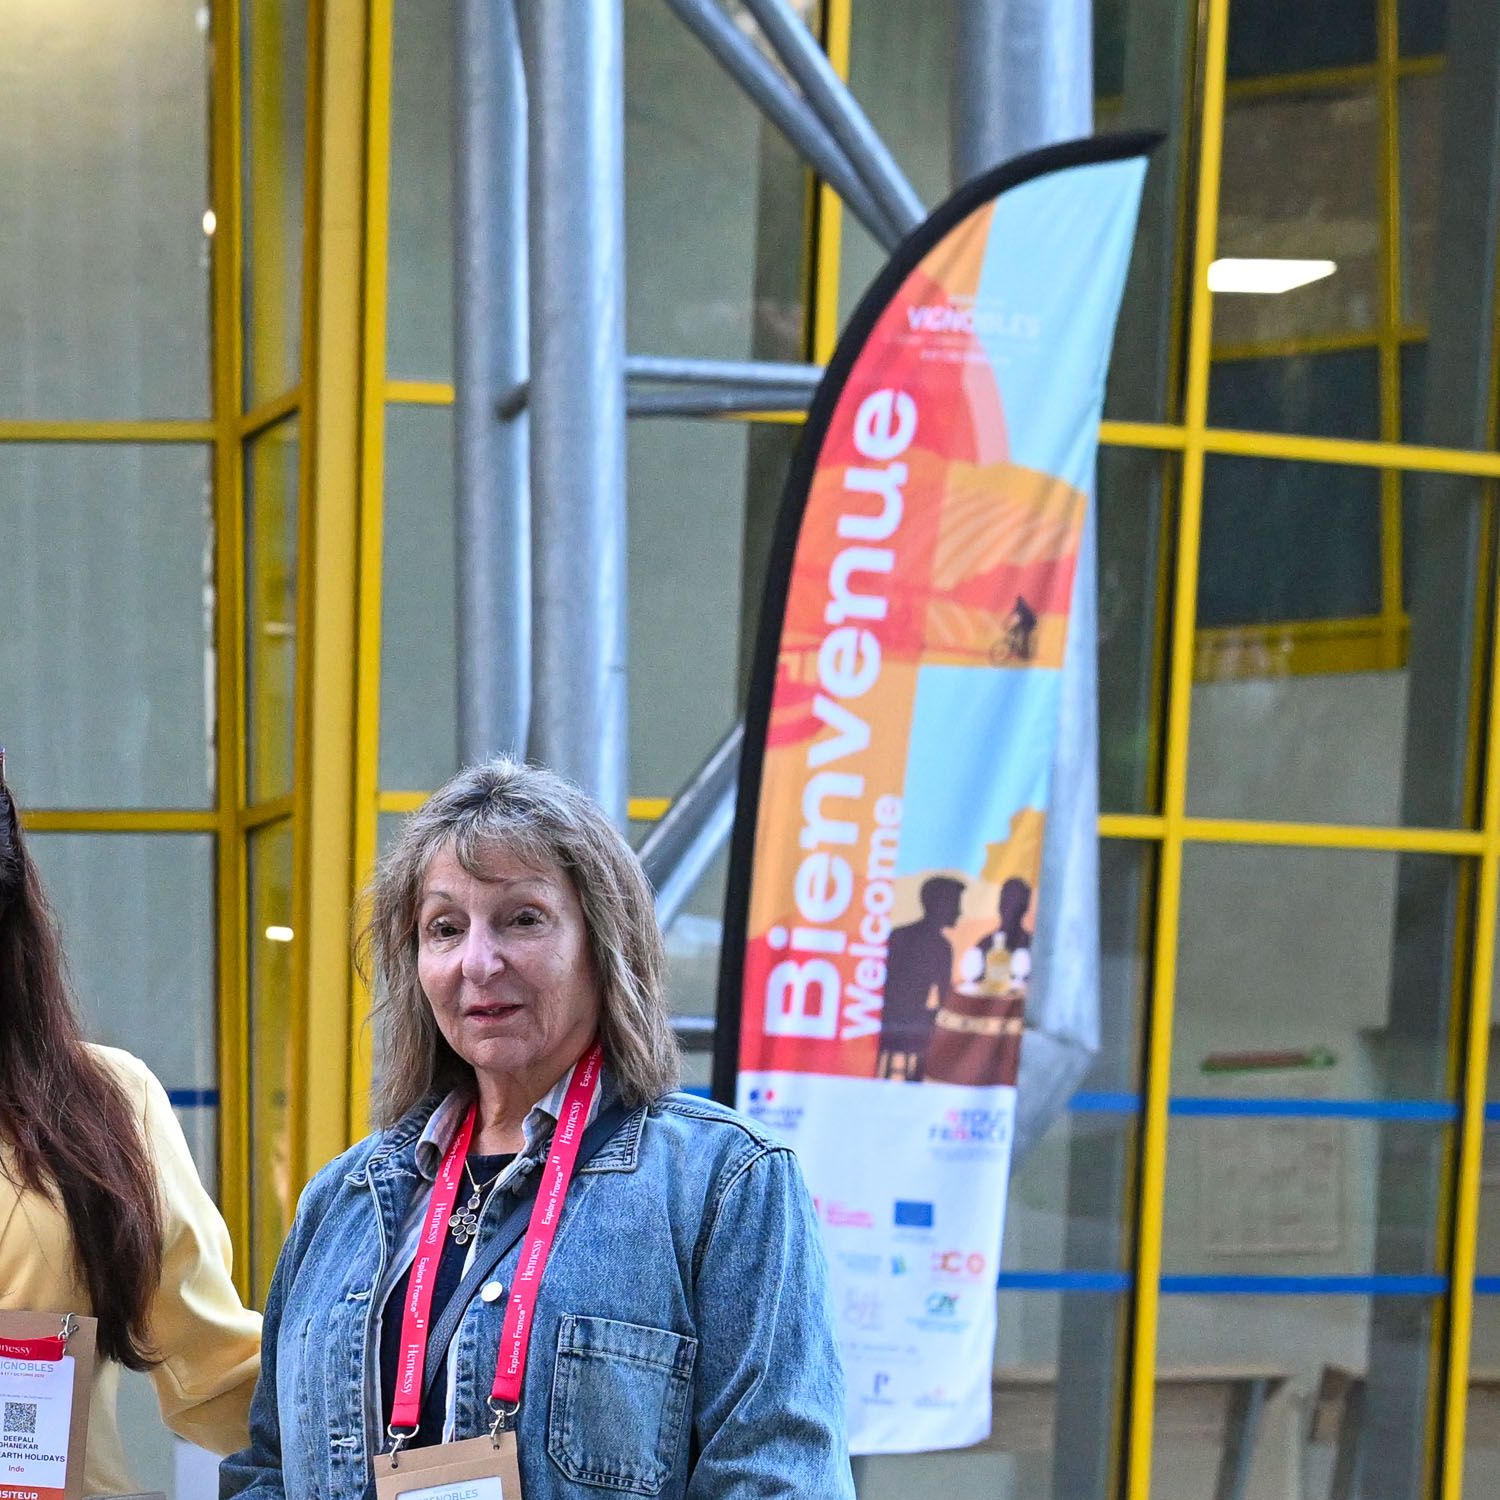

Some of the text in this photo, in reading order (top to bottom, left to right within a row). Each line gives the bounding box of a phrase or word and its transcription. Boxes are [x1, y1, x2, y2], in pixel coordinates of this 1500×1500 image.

[764, 389, 917, 1040] Bienvenue
[841, 794, 904, 1040] Welcome
[559, 1099, 584, 1145] Hennessy
[425, 1202, 447, 1246] Hennessy
[541, 1195, 557, 1226] Explore
[414, 1257, 430, 1284] Explore
[520, 1239, 546, 1281] Hennessy
[401, 1344, 419, 1395] Hennessy
[507, 1343, 521, 1374] Explore
[3, 1435, 34, 1443] DEEPALI
[8, 1465, 25, 1473] Inde
[24, 1453, 65, 1463] HOLIDAYS
